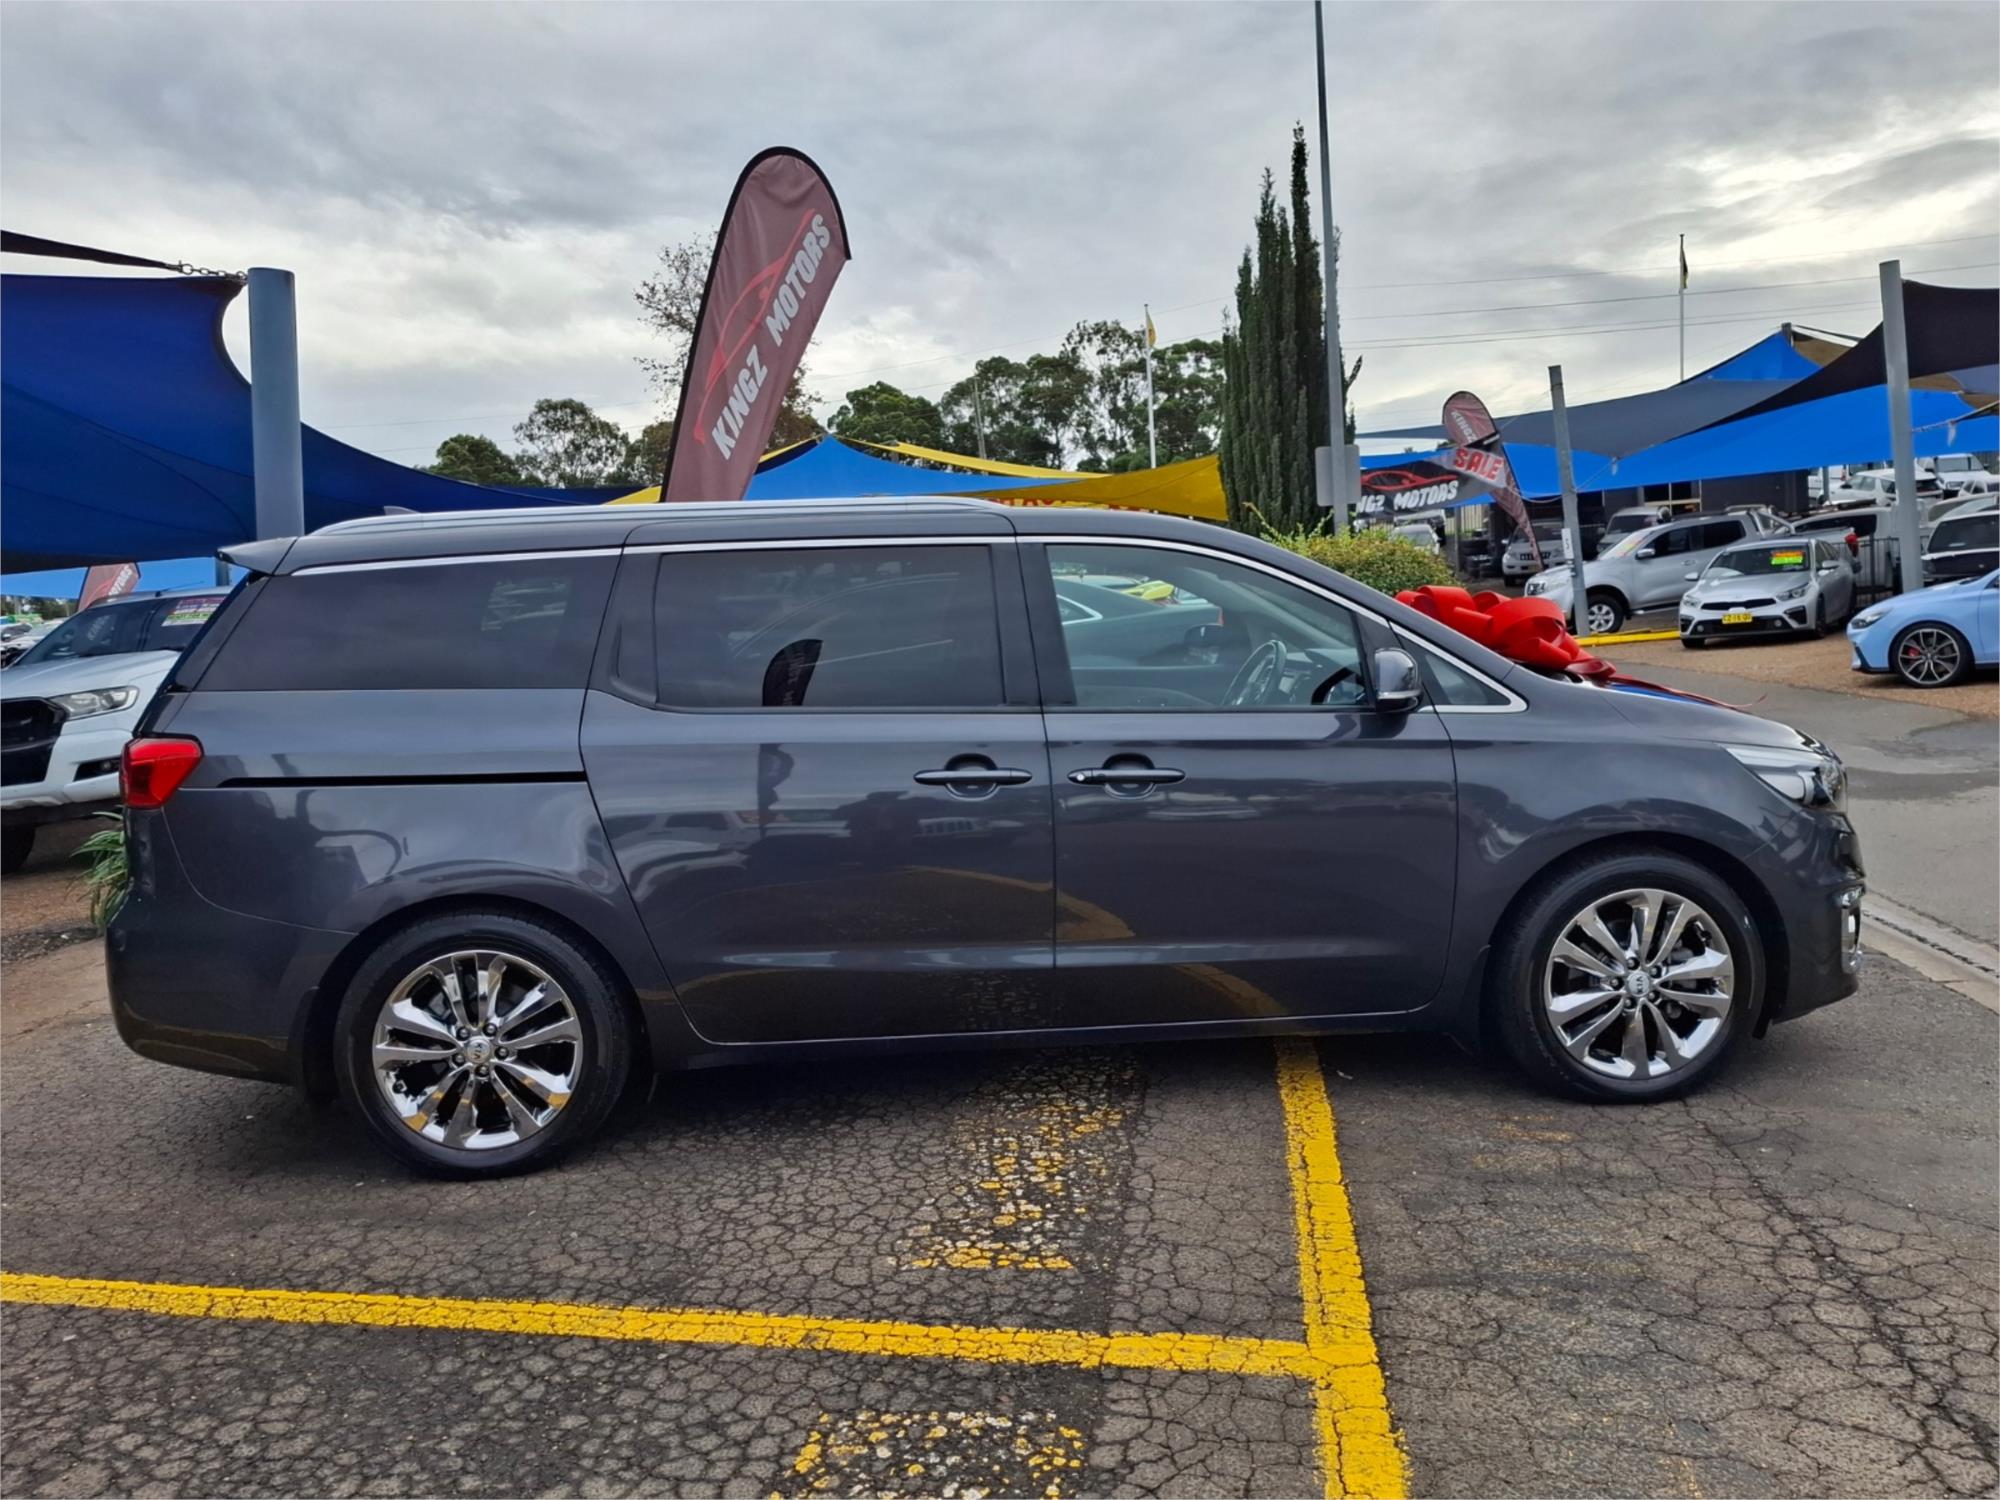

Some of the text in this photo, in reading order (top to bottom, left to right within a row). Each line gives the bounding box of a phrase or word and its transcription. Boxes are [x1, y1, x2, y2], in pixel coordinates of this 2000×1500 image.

[711, 213, 831, 461] KINGZ MOTORS
[1451, 410, 1478, 443] KINGZ
[1454, 448, 1503, 480] SALE
[1394, 480, 1459, 510] MOTORS
